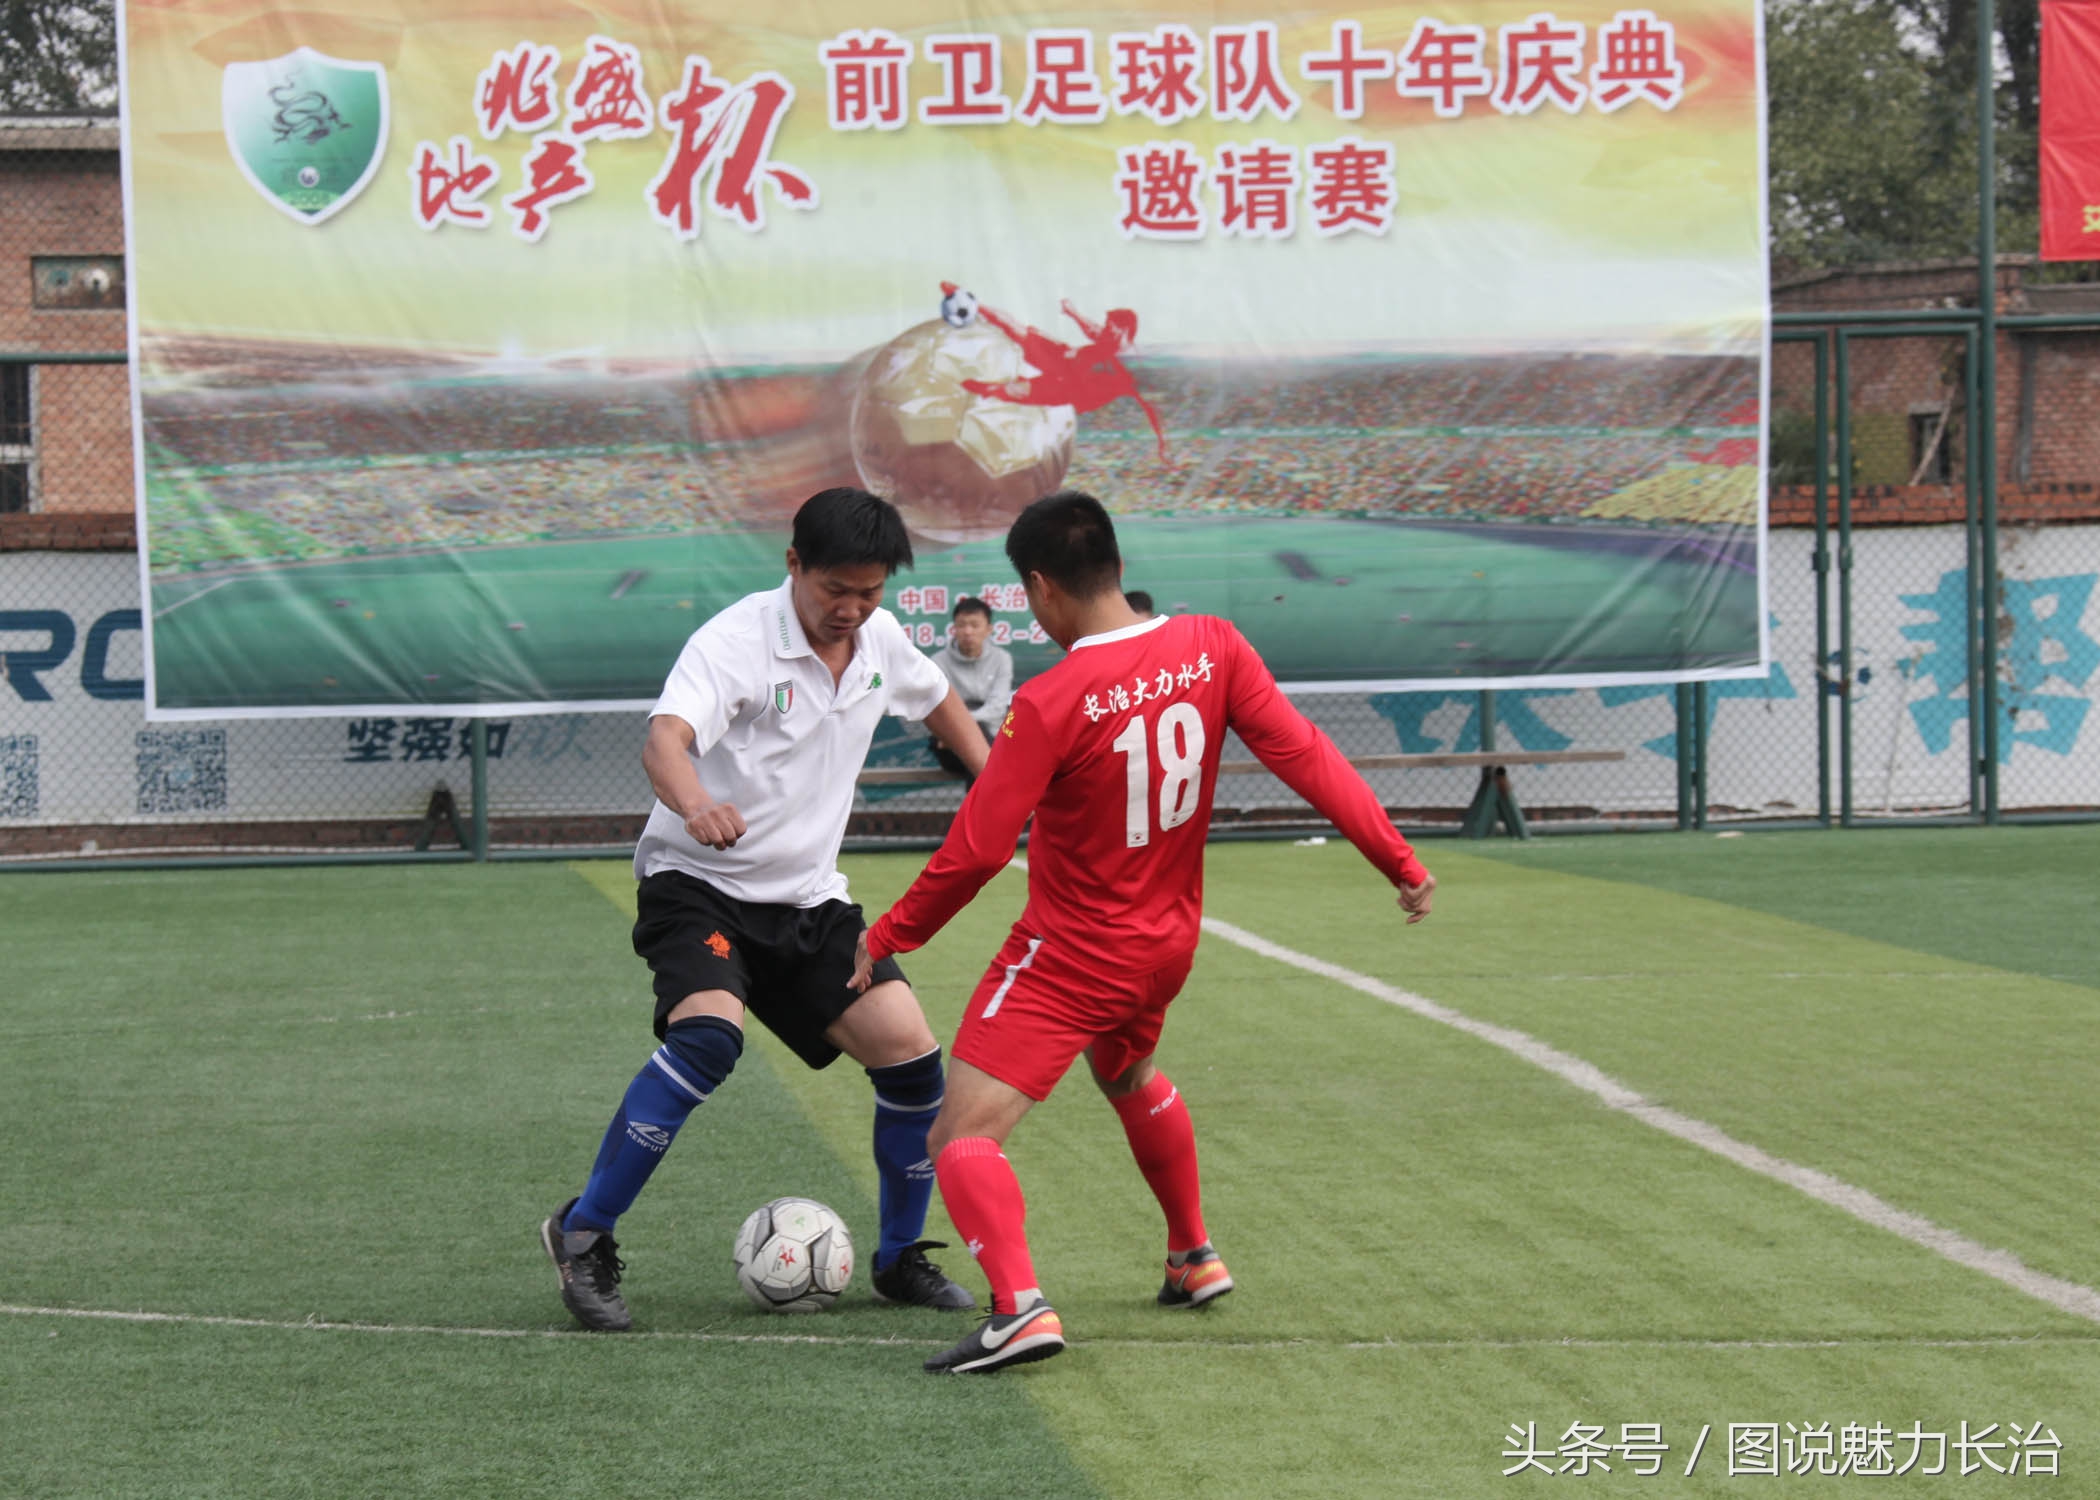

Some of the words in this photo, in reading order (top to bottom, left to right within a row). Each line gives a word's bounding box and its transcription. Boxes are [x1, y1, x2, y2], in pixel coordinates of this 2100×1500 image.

[481, 43, 647, 134] 兆盛
[827, 18, 1676, 123] 前卫足球队十年庆典
[417, 139, 588, 233] 地产
[653, 65, 812, 231] 杯
[1120, 143, 1390, 232] 邀请赛
[1083, 652, 1215, 722] 长治大力水手
[1113, 701, 1206, 848] 18
